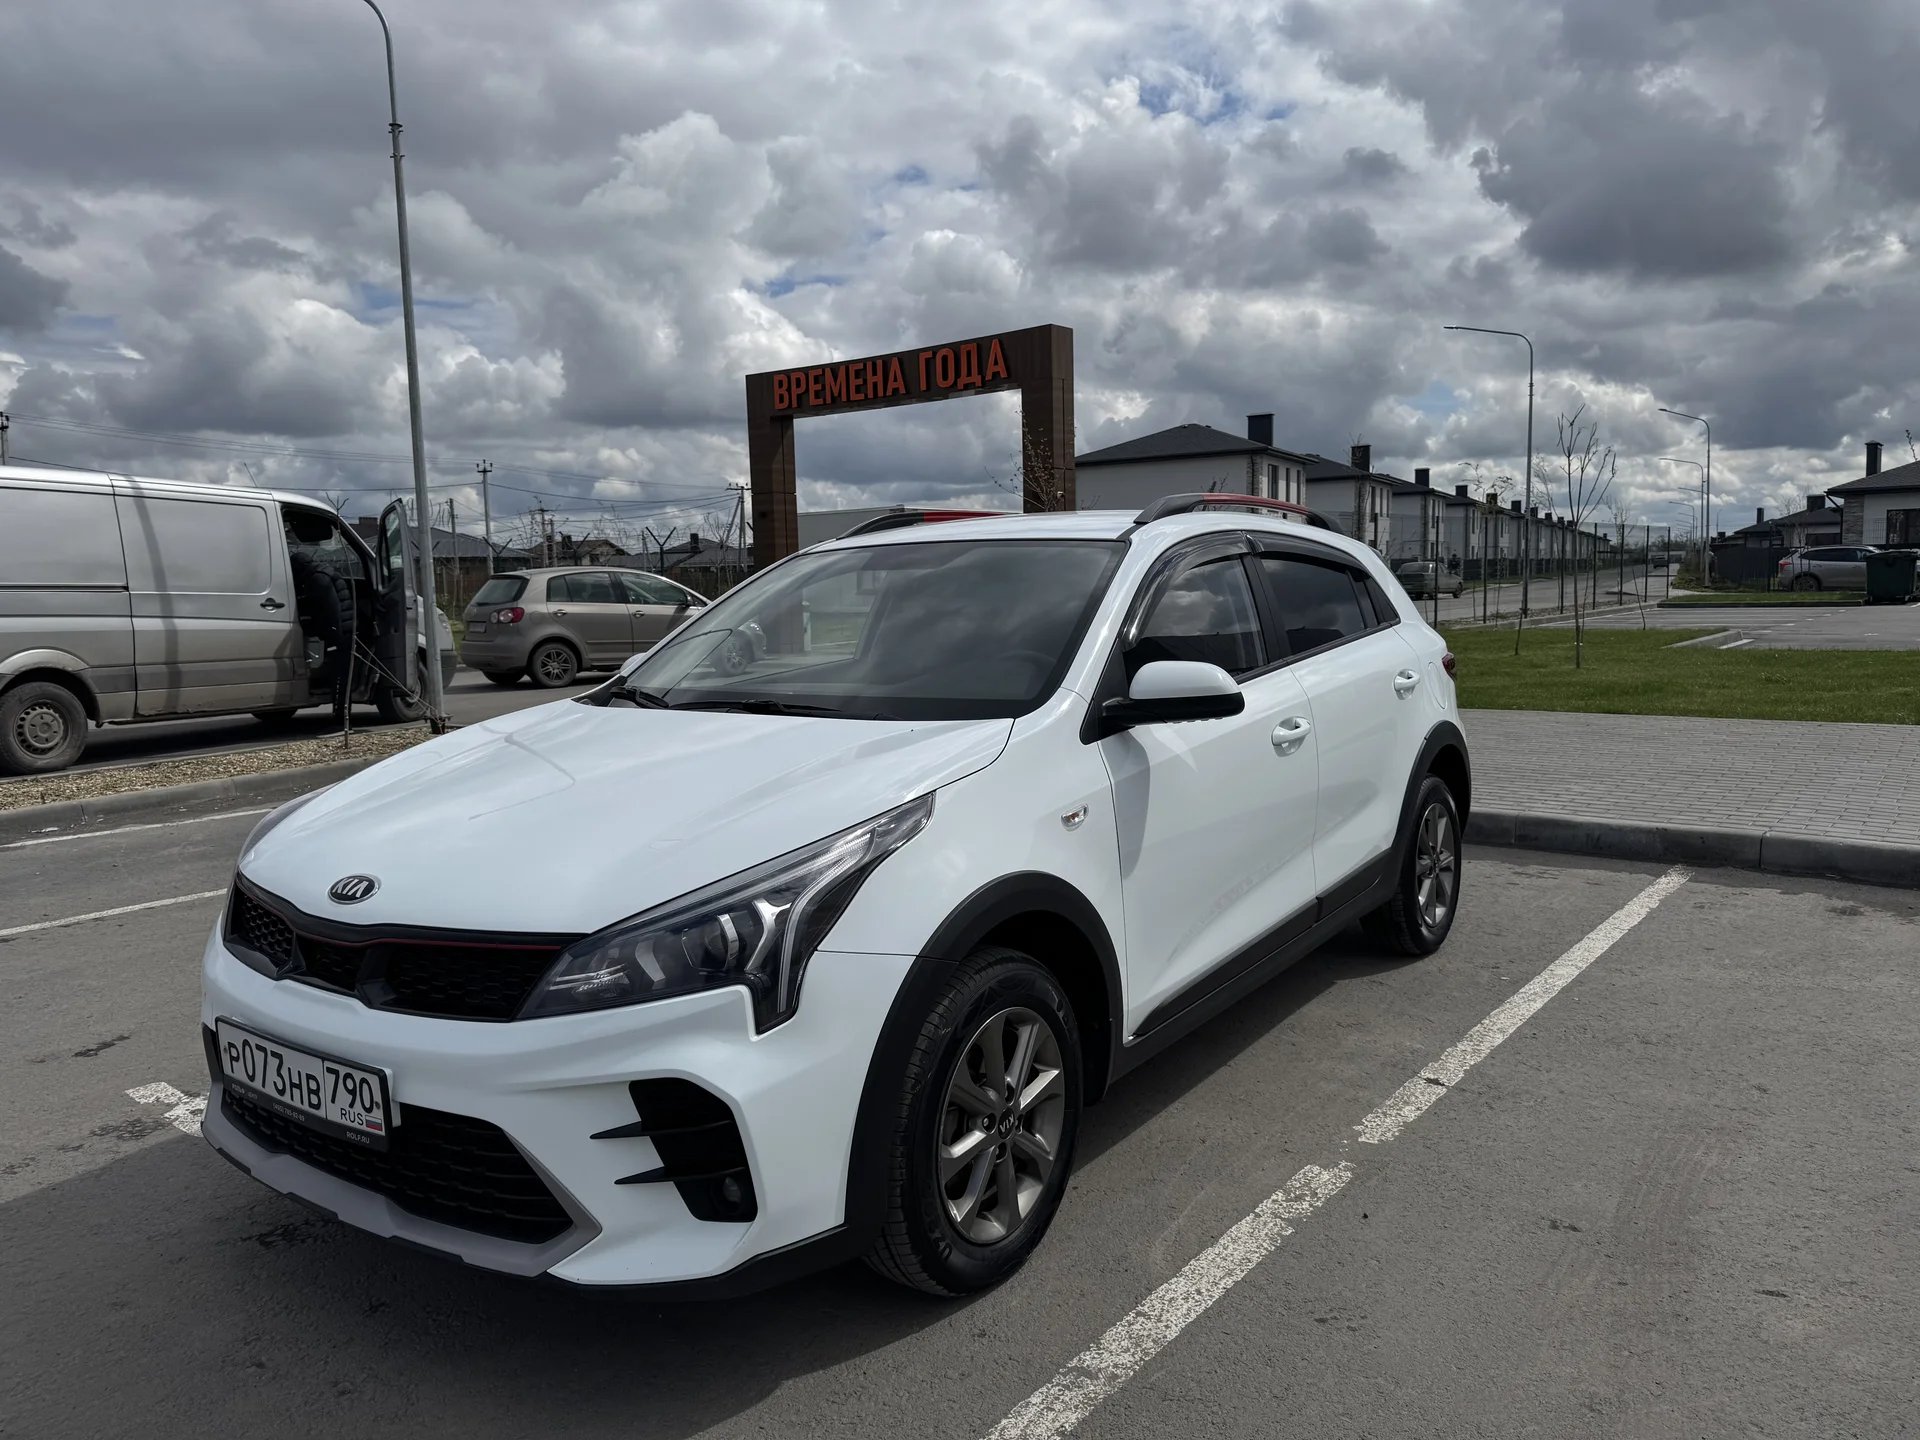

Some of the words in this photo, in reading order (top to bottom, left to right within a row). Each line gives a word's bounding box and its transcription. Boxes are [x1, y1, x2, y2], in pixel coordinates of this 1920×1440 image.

[773, 357, 906, 410] ВРЕМЕНА
[919, 339, 1008, 391] ГОДА
[332, 878, 369, 898] KIA
[326, 1066, 374, 1114] 790
[340, 1107, 364, 1126] RUS
[999, 1113, 1014, 1133] KIA
[346, 1131, 370, 1144] ROLF.RU
